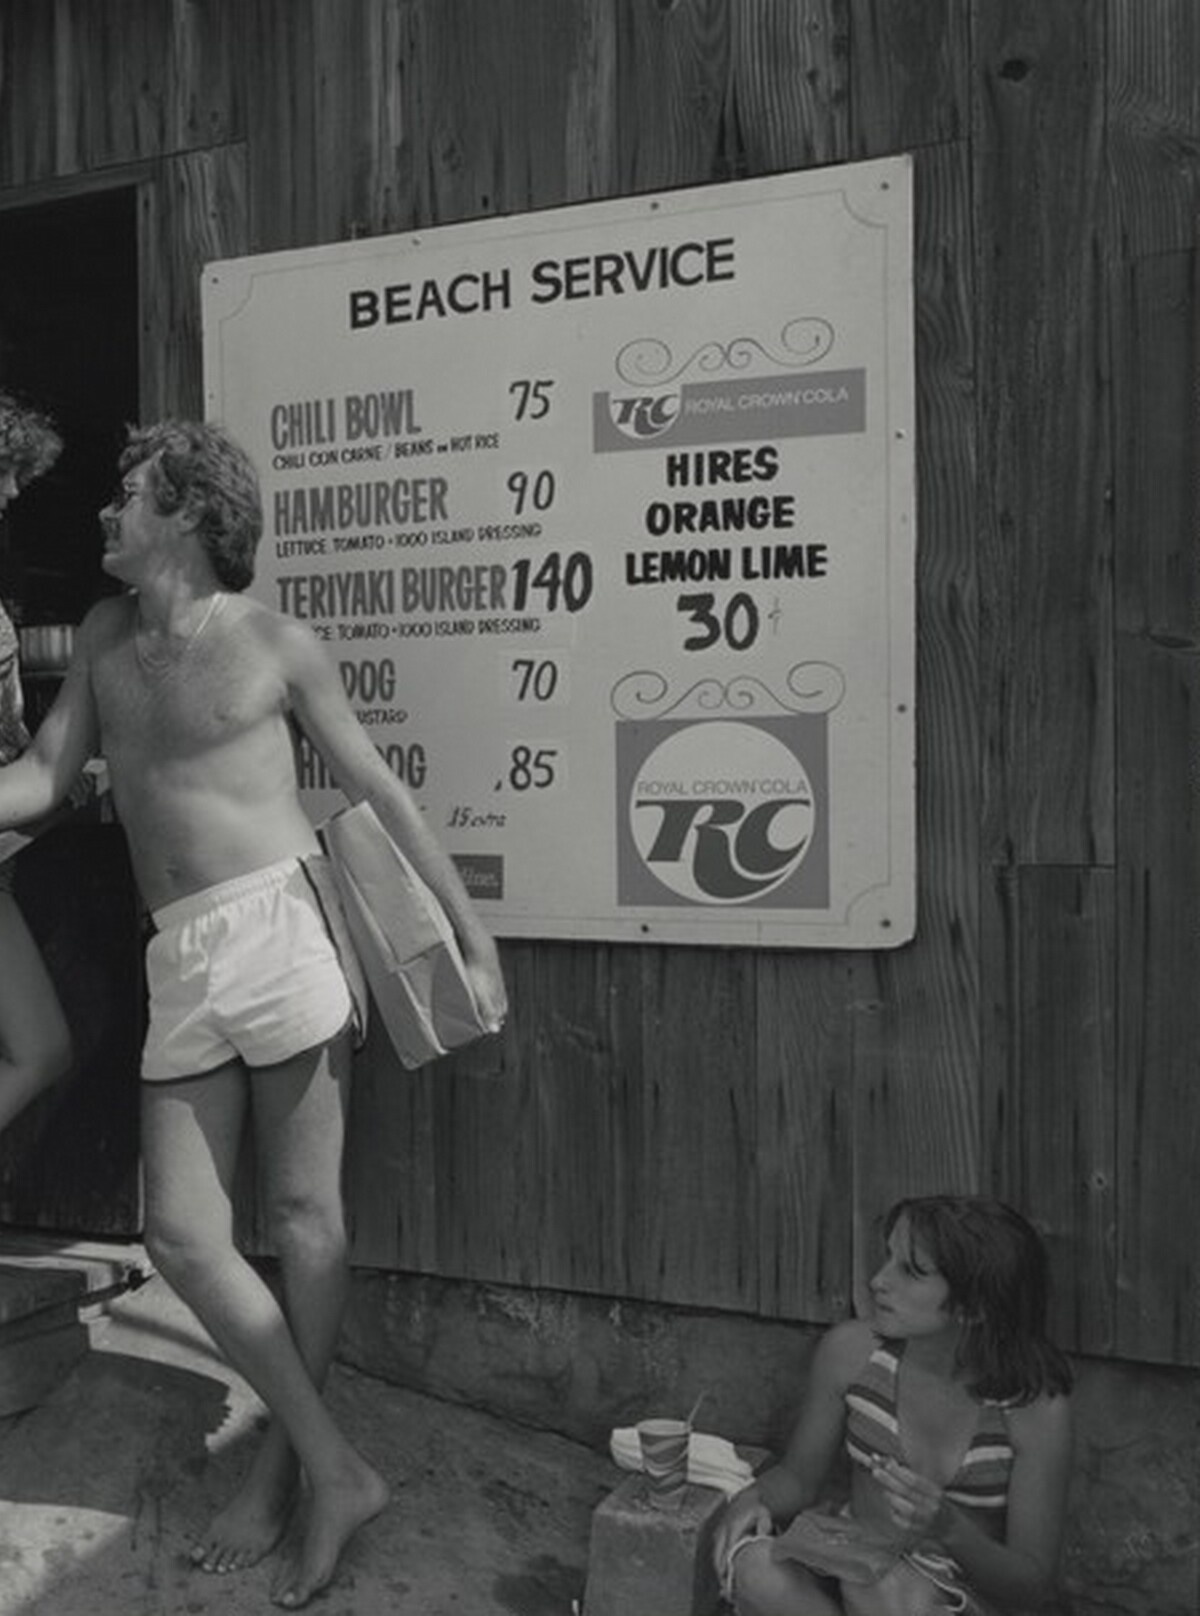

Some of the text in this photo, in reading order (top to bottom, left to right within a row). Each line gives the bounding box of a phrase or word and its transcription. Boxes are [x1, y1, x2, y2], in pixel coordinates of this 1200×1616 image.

[349, 237, 735, 330] BEACH SERVICE
[270, 388, 422, 451] CHILI BOWL
[509, 380, 555, 421] 75
[613, 394, 680, 436] RC
[685, 386, 849, 415] ROYAL CROWN COLA
[272, 454, 305, 470] CHILI
[308, 450, 339, 467] CON
[666, 445, 779, 487] HIRES
[273, 477, 449, 537] HAMBURGER
[507, 470, 555, 516] 90
[646, 495, 795, 537] ORANGE
[276, 538, 327, 559] LETTUCE
[332, 535, 385, 553] TOMATO
[431, 526, 475, 545] ISLAND
[477, 522, 543, 542] DRESSING
[511, 551, 593, 613] 140
[625, 544, 828, 586] LEMON LIME
[276, 564, 508, 620] TERIYAKI BURGER
[337, 622, 390, 641] TOMATO
[435, 619, 476, 637] ISLAND
[478, 617, 541, 635] DRESSING
[676, 592, 759, 651] 30
[339, 658, 396, 703] DOG
[512, 658, 558, 701] 70
[356, 707, 409, 726] USTARD
[637, 778, 809, 795] ROYAL CROWN COLA
[635, 798, 812, 899] RC
